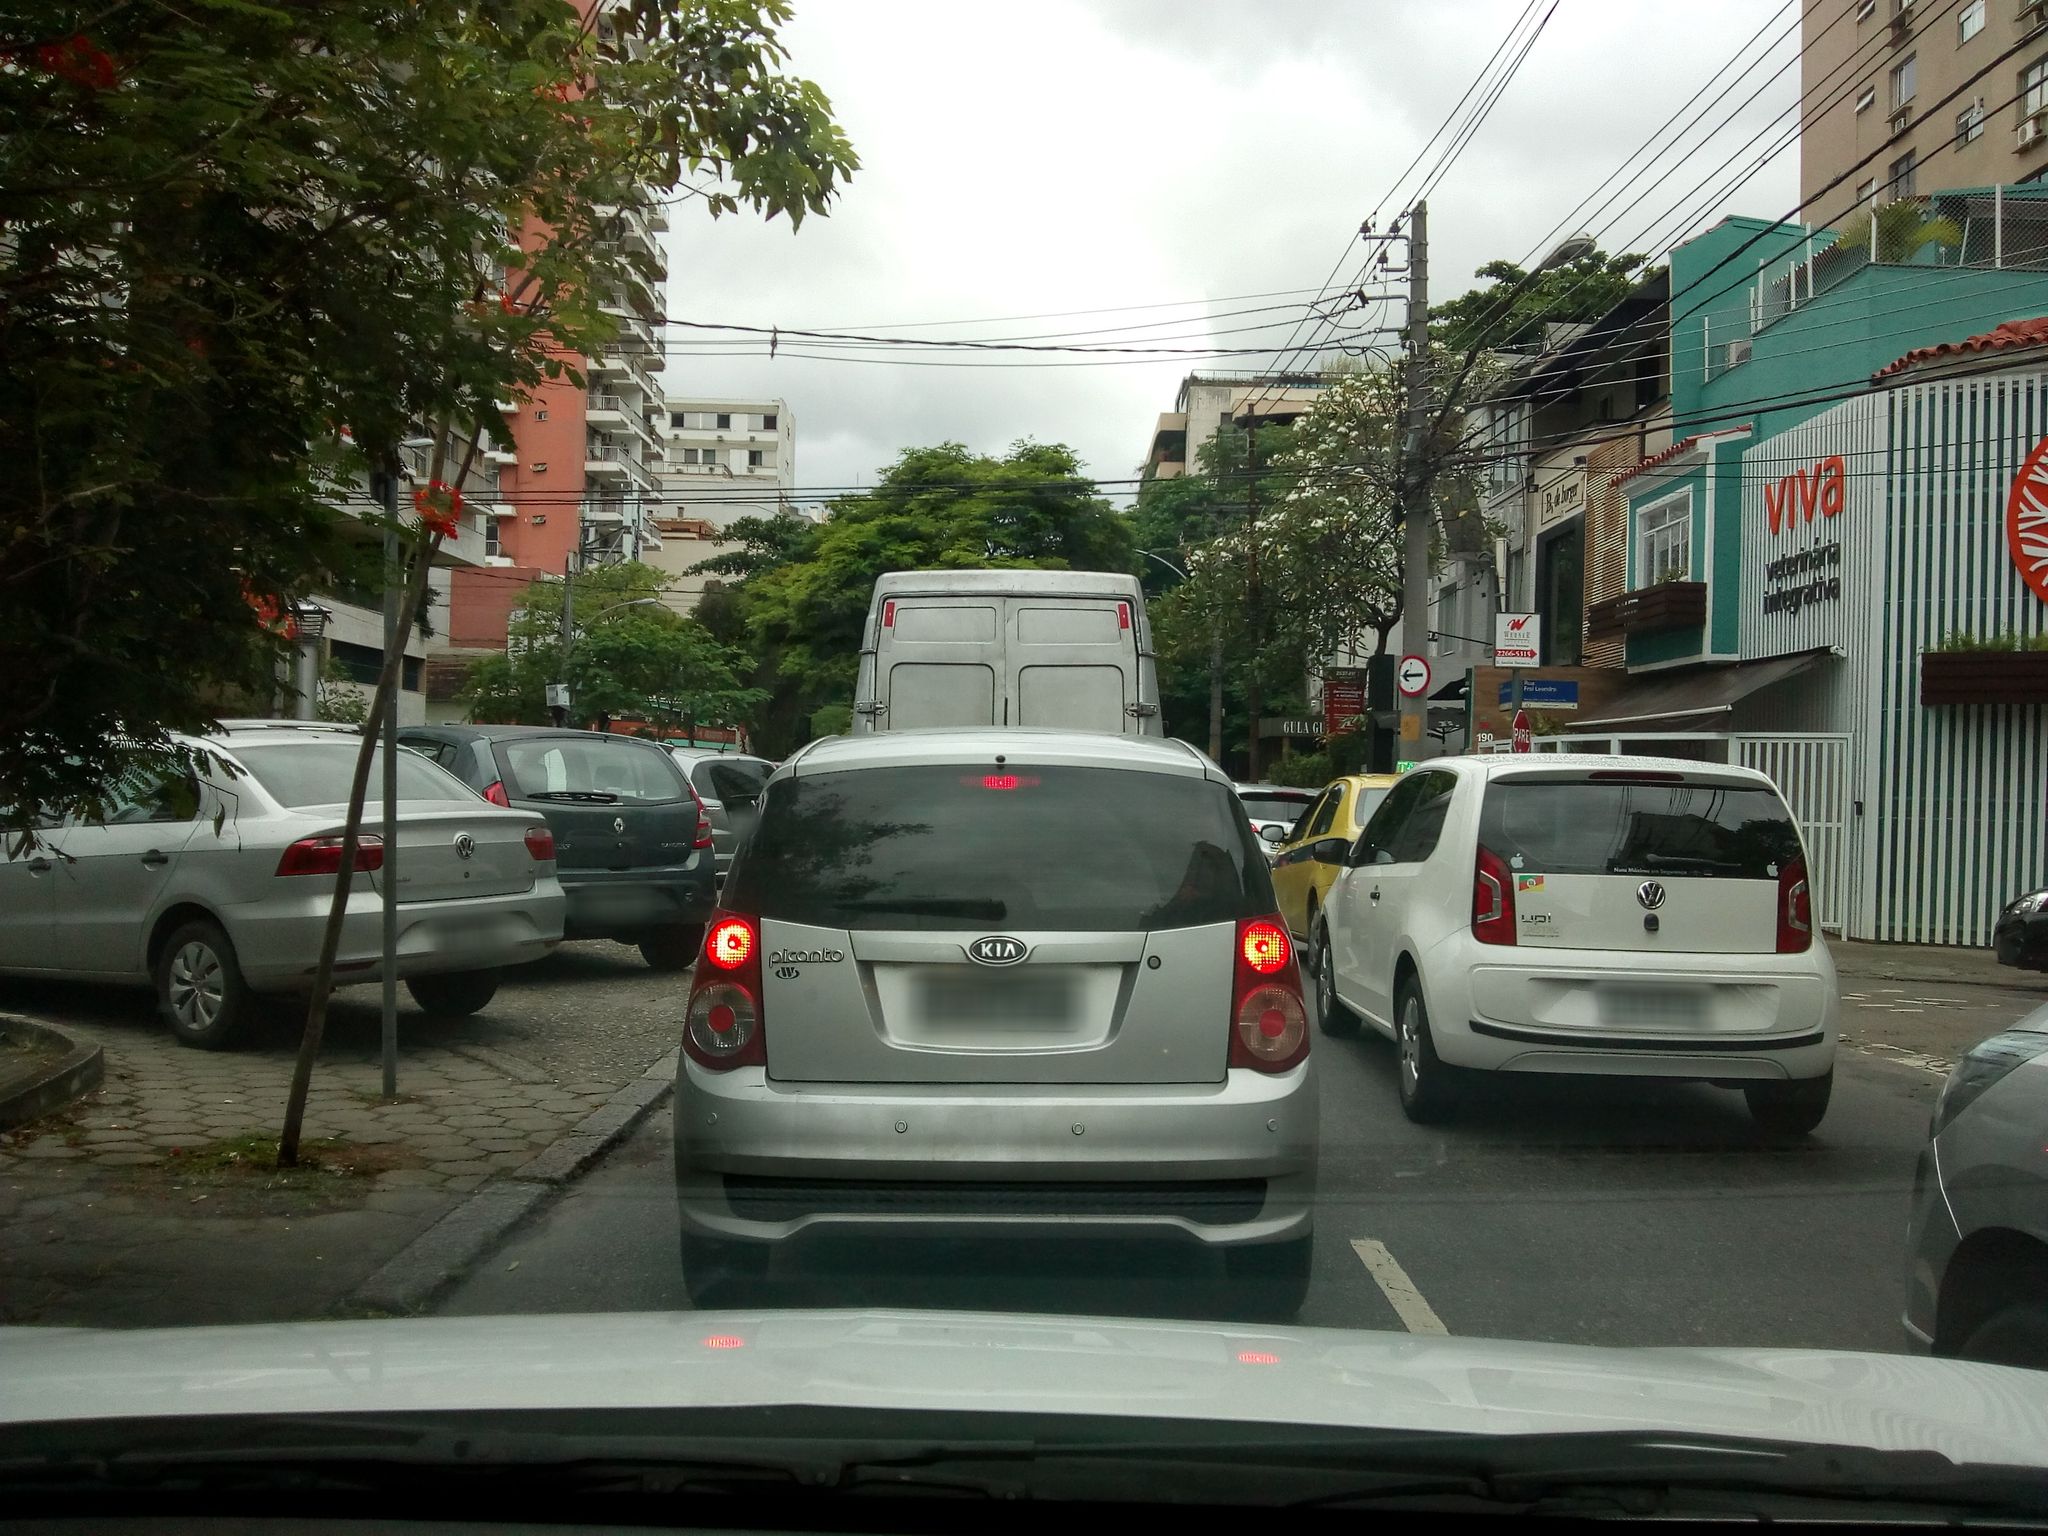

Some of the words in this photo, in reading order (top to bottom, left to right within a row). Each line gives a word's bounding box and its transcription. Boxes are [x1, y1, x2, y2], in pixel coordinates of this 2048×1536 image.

[1764, 536, 1841, 582] veterinária
[1763, 574, 1841, 615] integrativa
[1283, 721, 1309, 734] GULA
[1514, 727, 1530, 744] PARE
[1477, 733, 1493, 742] 190
[1521, 912, 1552, 926] up!
[768, 947, 845, 968] picanto
[980, 942, 1016, 959] KIA
